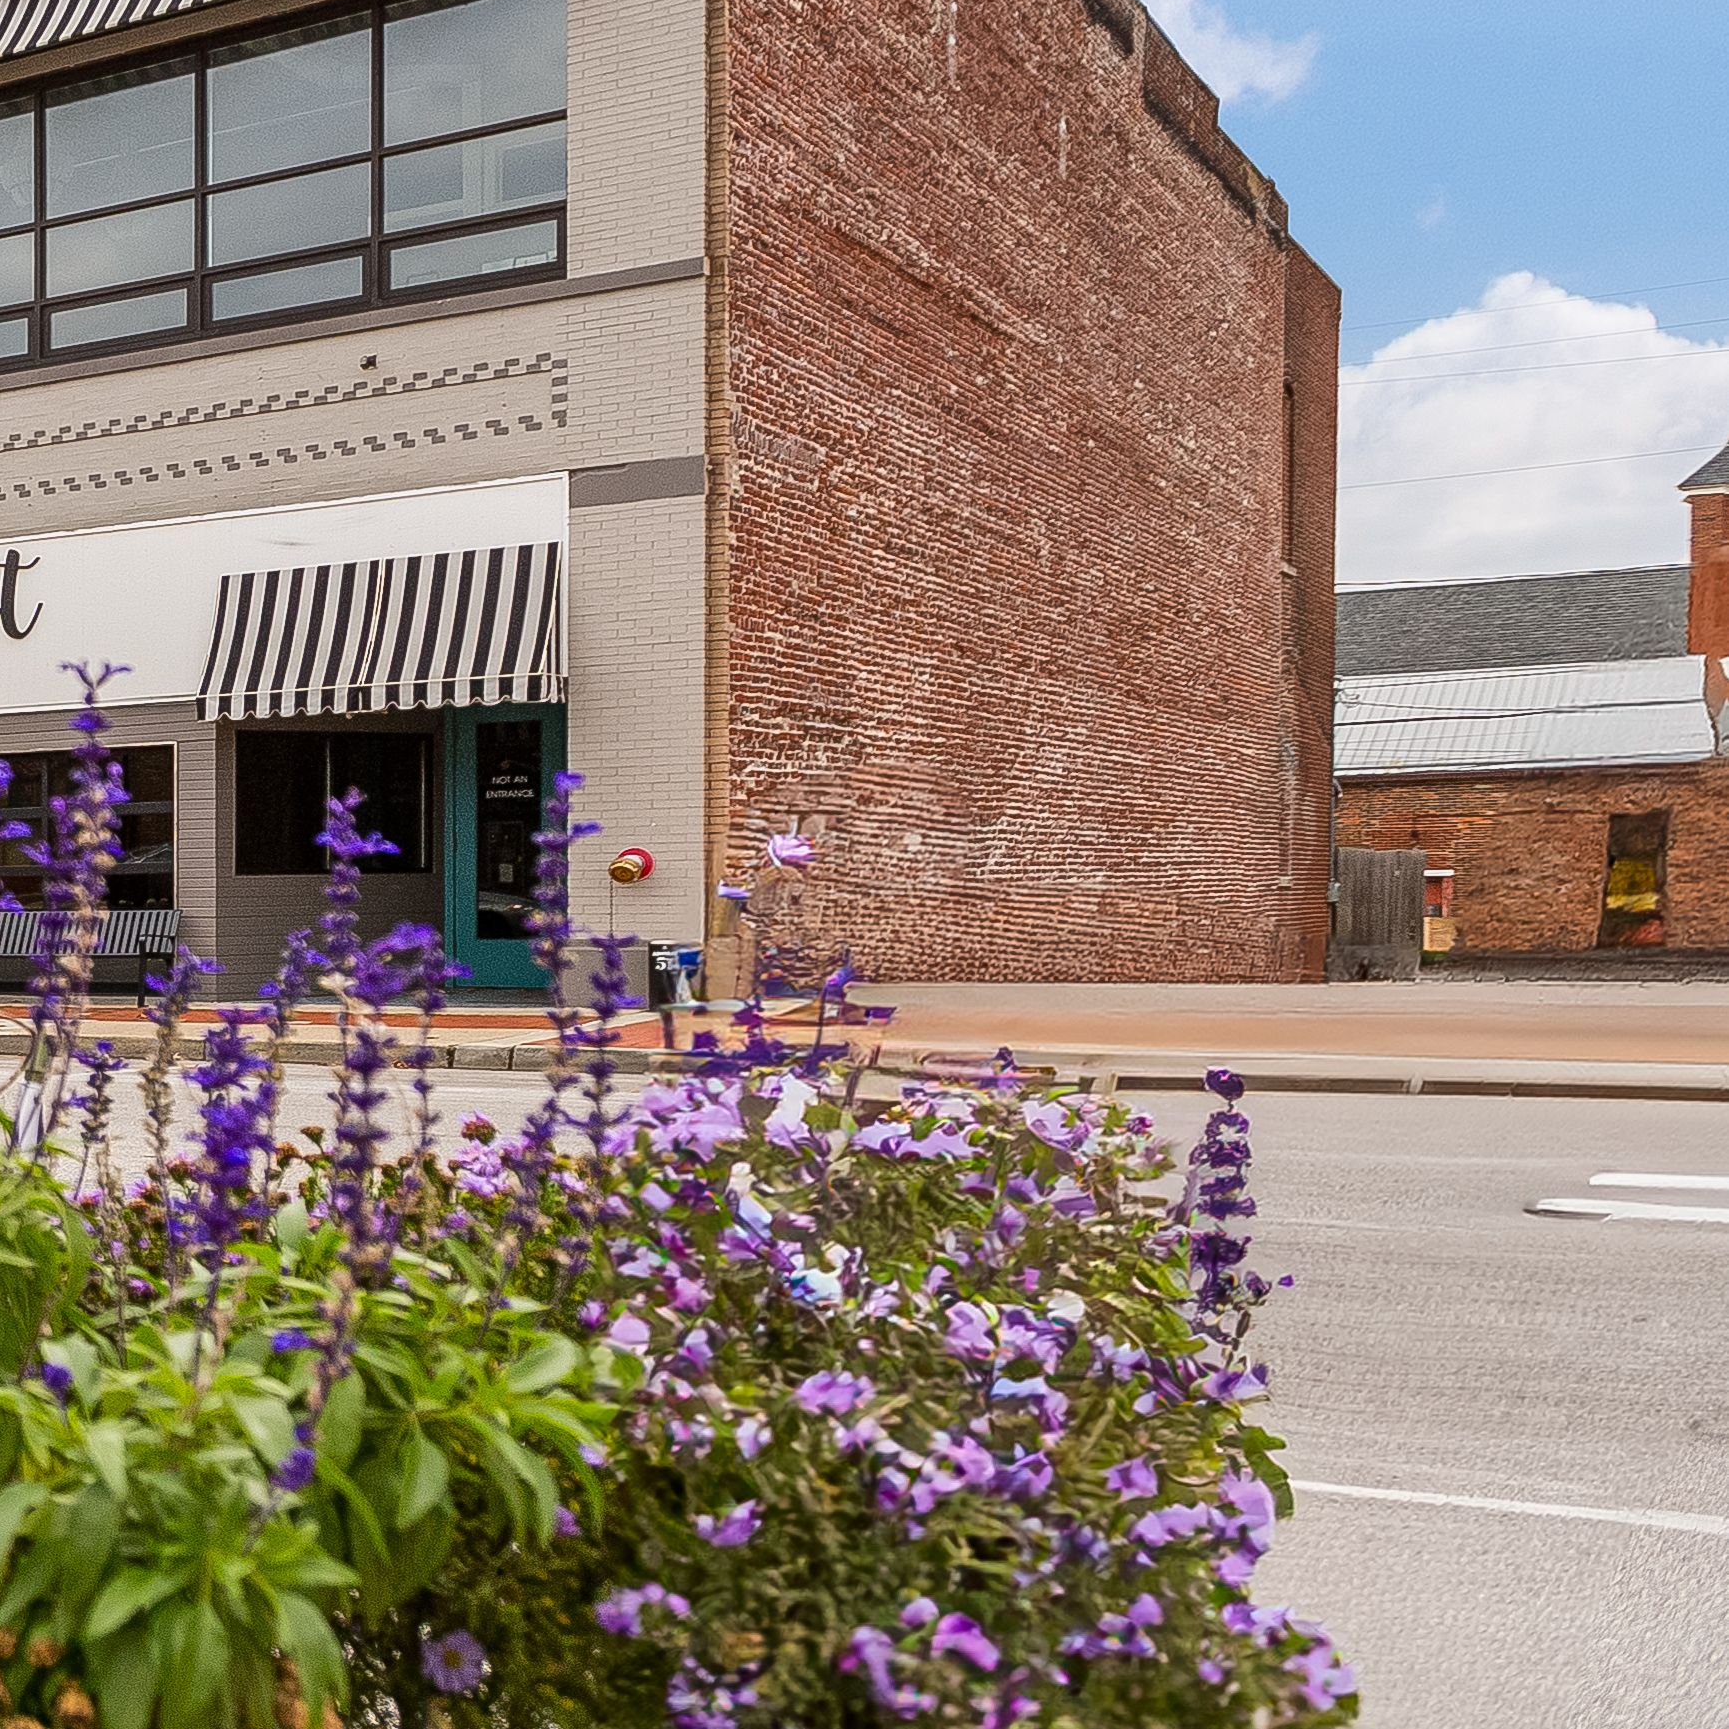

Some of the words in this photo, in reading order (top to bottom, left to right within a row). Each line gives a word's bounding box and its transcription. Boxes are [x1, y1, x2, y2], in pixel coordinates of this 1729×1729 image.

[491, 775, 511, 784] NOT
[513, 775, 528, 784] AN
[486, 789, 534, 799] ENTRANCE
